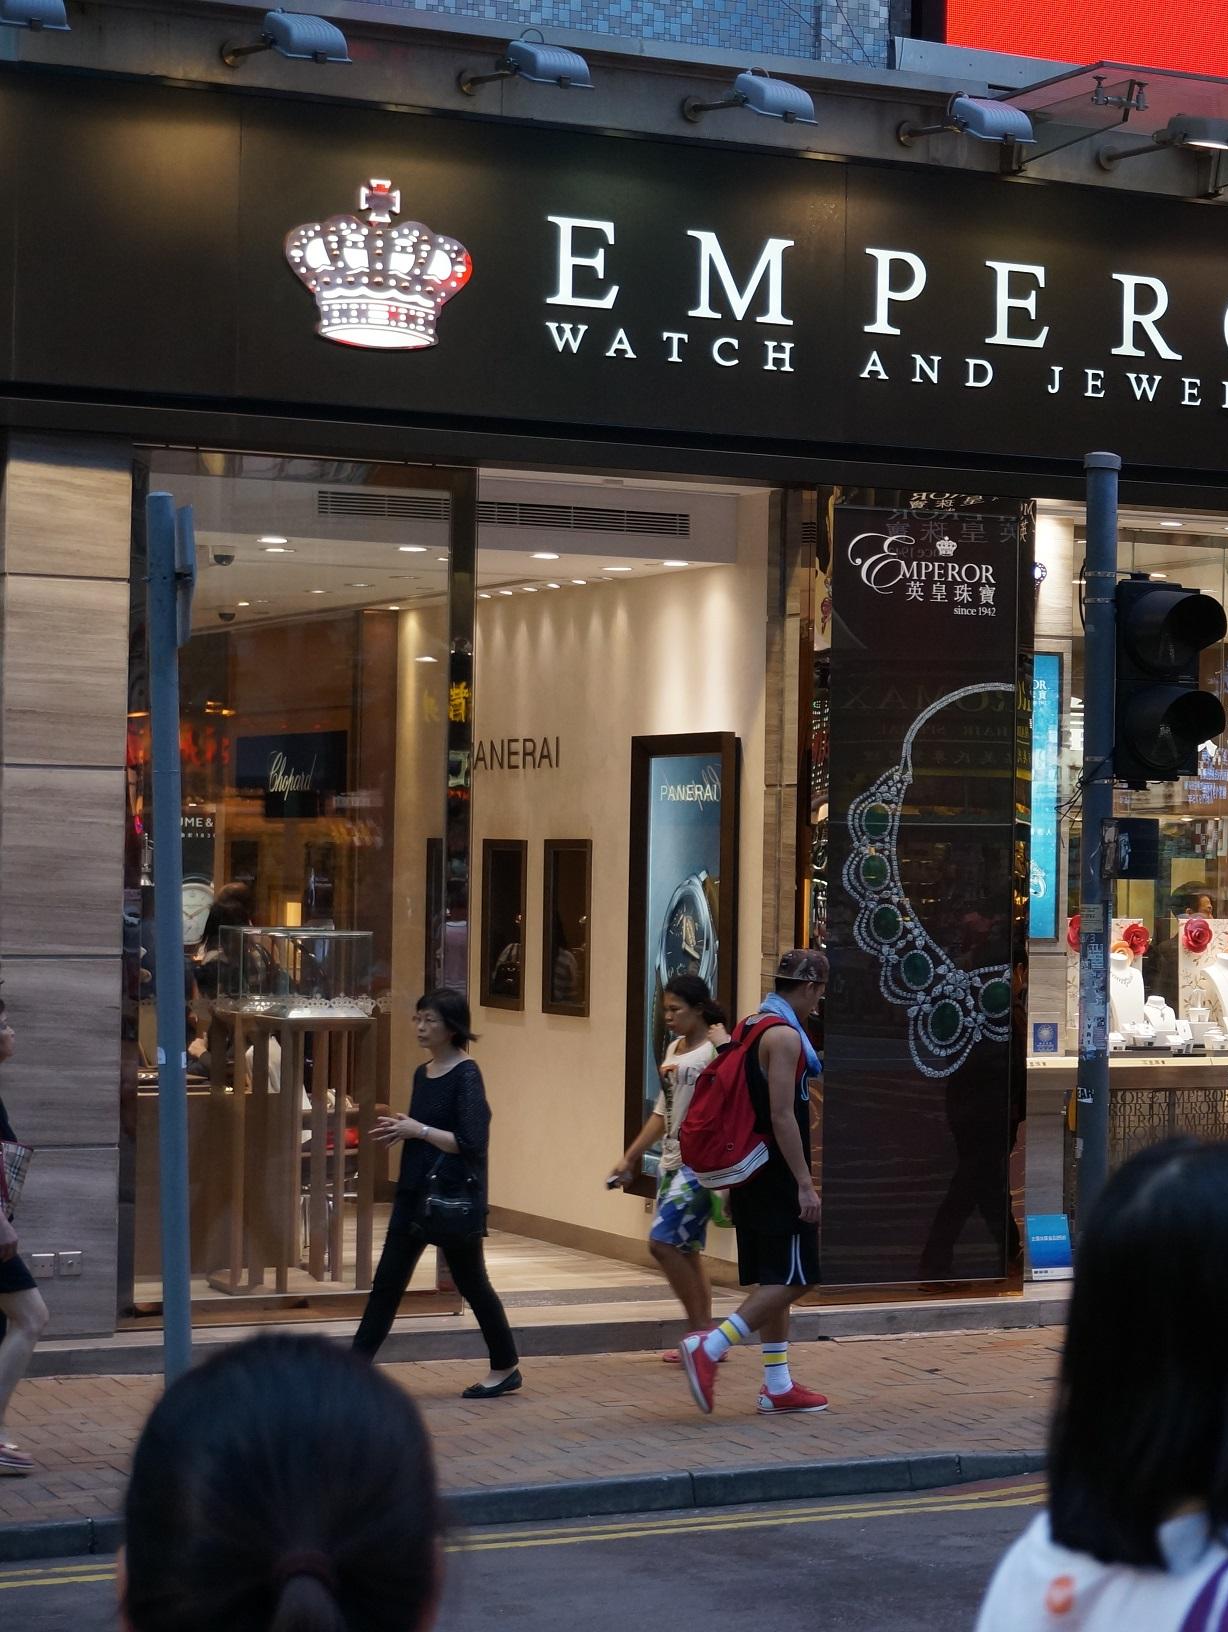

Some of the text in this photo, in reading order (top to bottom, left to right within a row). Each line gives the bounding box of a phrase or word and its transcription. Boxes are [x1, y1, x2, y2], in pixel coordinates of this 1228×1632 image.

[546, 321, 795, 372] WATCH
[859, 350, 994, 388] AND
[848, 532, 997, 594] EMPEROR
[905, 580, 996, 605] 英皇珠寶
[953, 605, 997, 617] since 1942
[473, 736, 560, 770] ANERAI
[268, 751, 317, 800] Chopard
[660, 784, 719, 801] PANERAI
[180, 817, 203, 828] ME
